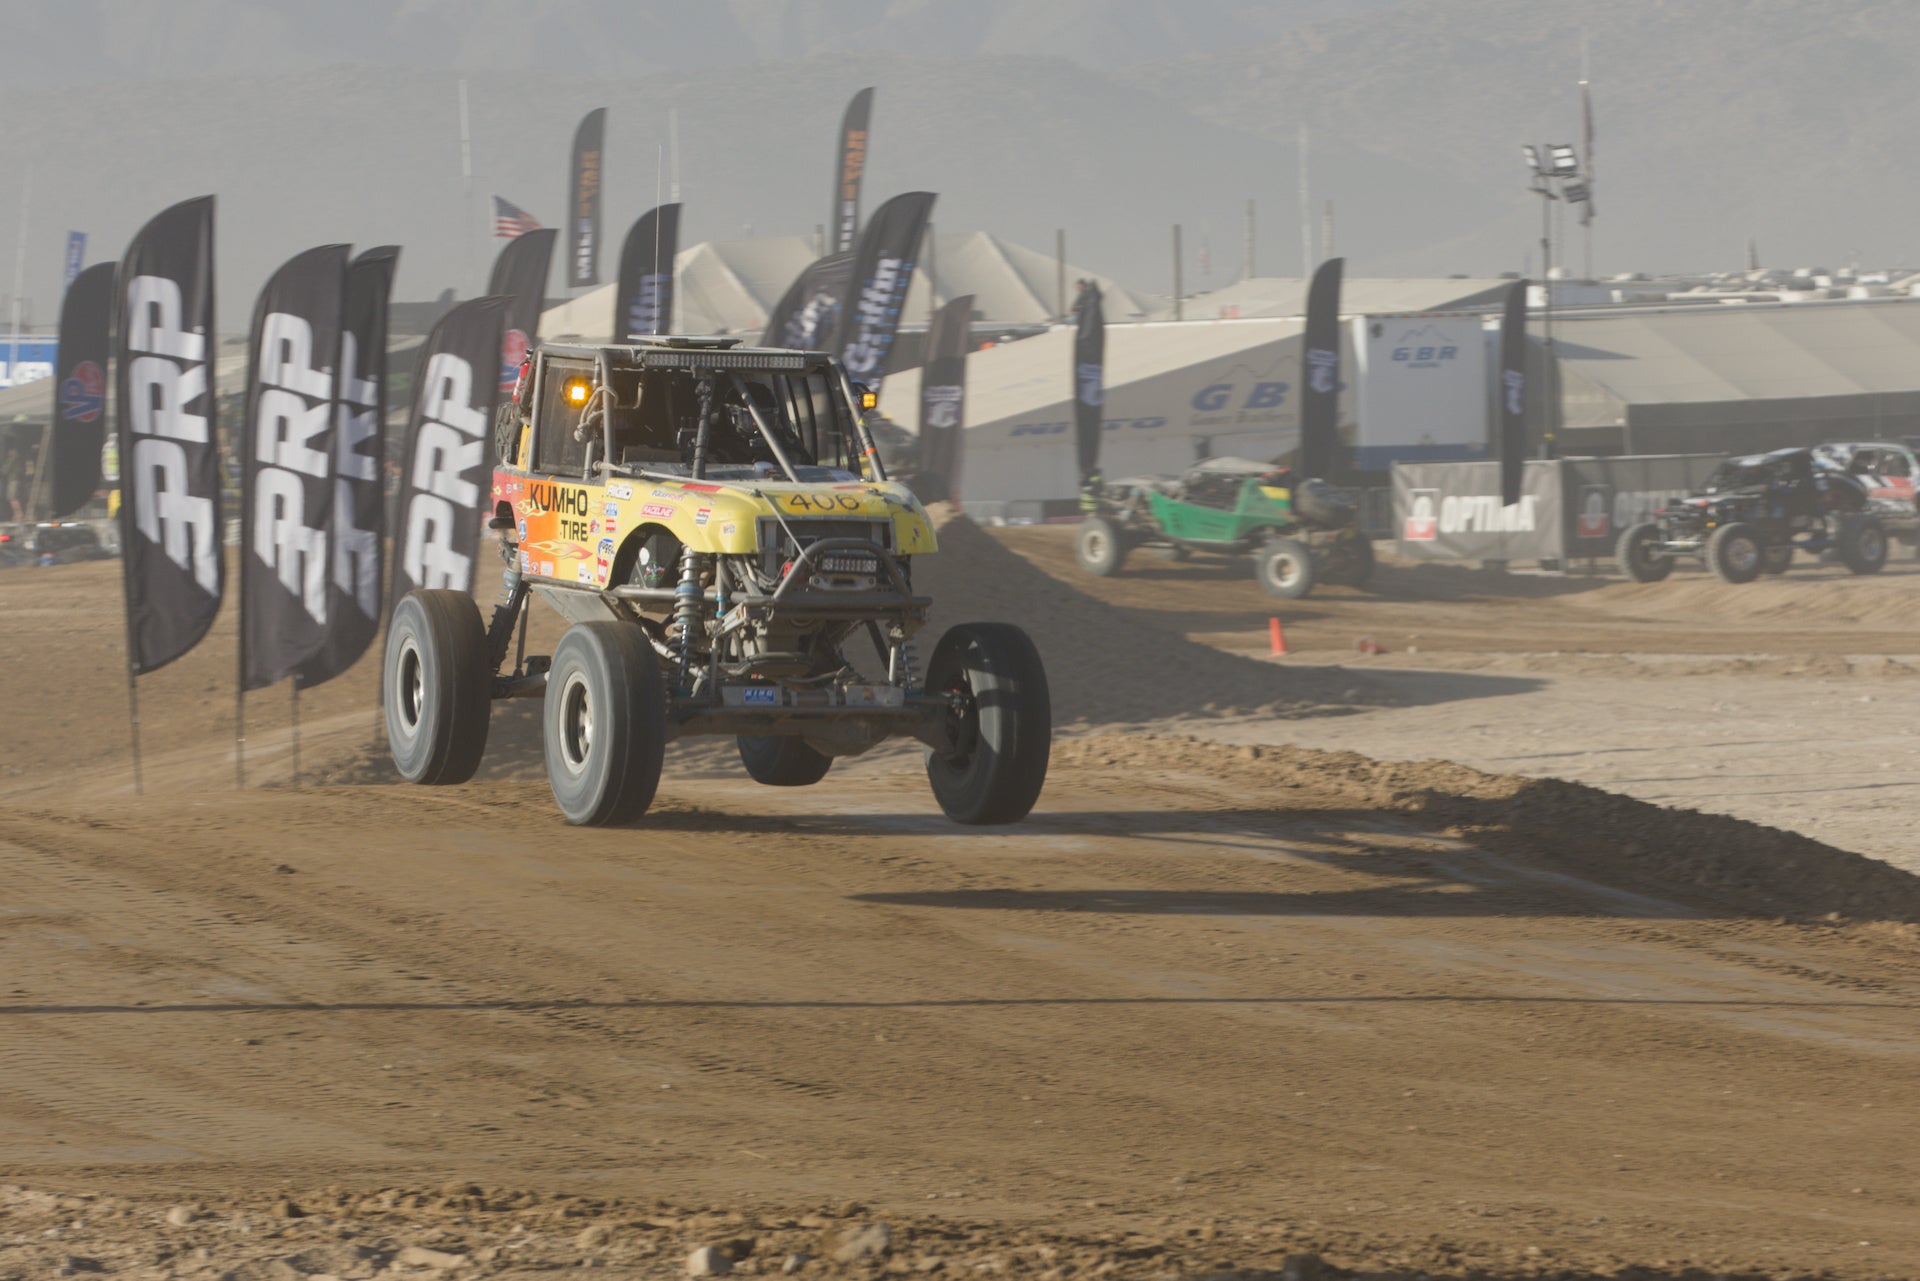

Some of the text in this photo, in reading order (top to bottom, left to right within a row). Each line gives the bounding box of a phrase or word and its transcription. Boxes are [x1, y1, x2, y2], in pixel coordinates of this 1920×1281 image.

[127, 274, 218, 598] PRP
[253, 312, 333, 625] PRP
[404, 353, 488, 592] PRP
[530, 483, 588, 517] KUMHO
[790, 494, 860, 511] 406
[561, 520, 588, 542] TIRE
